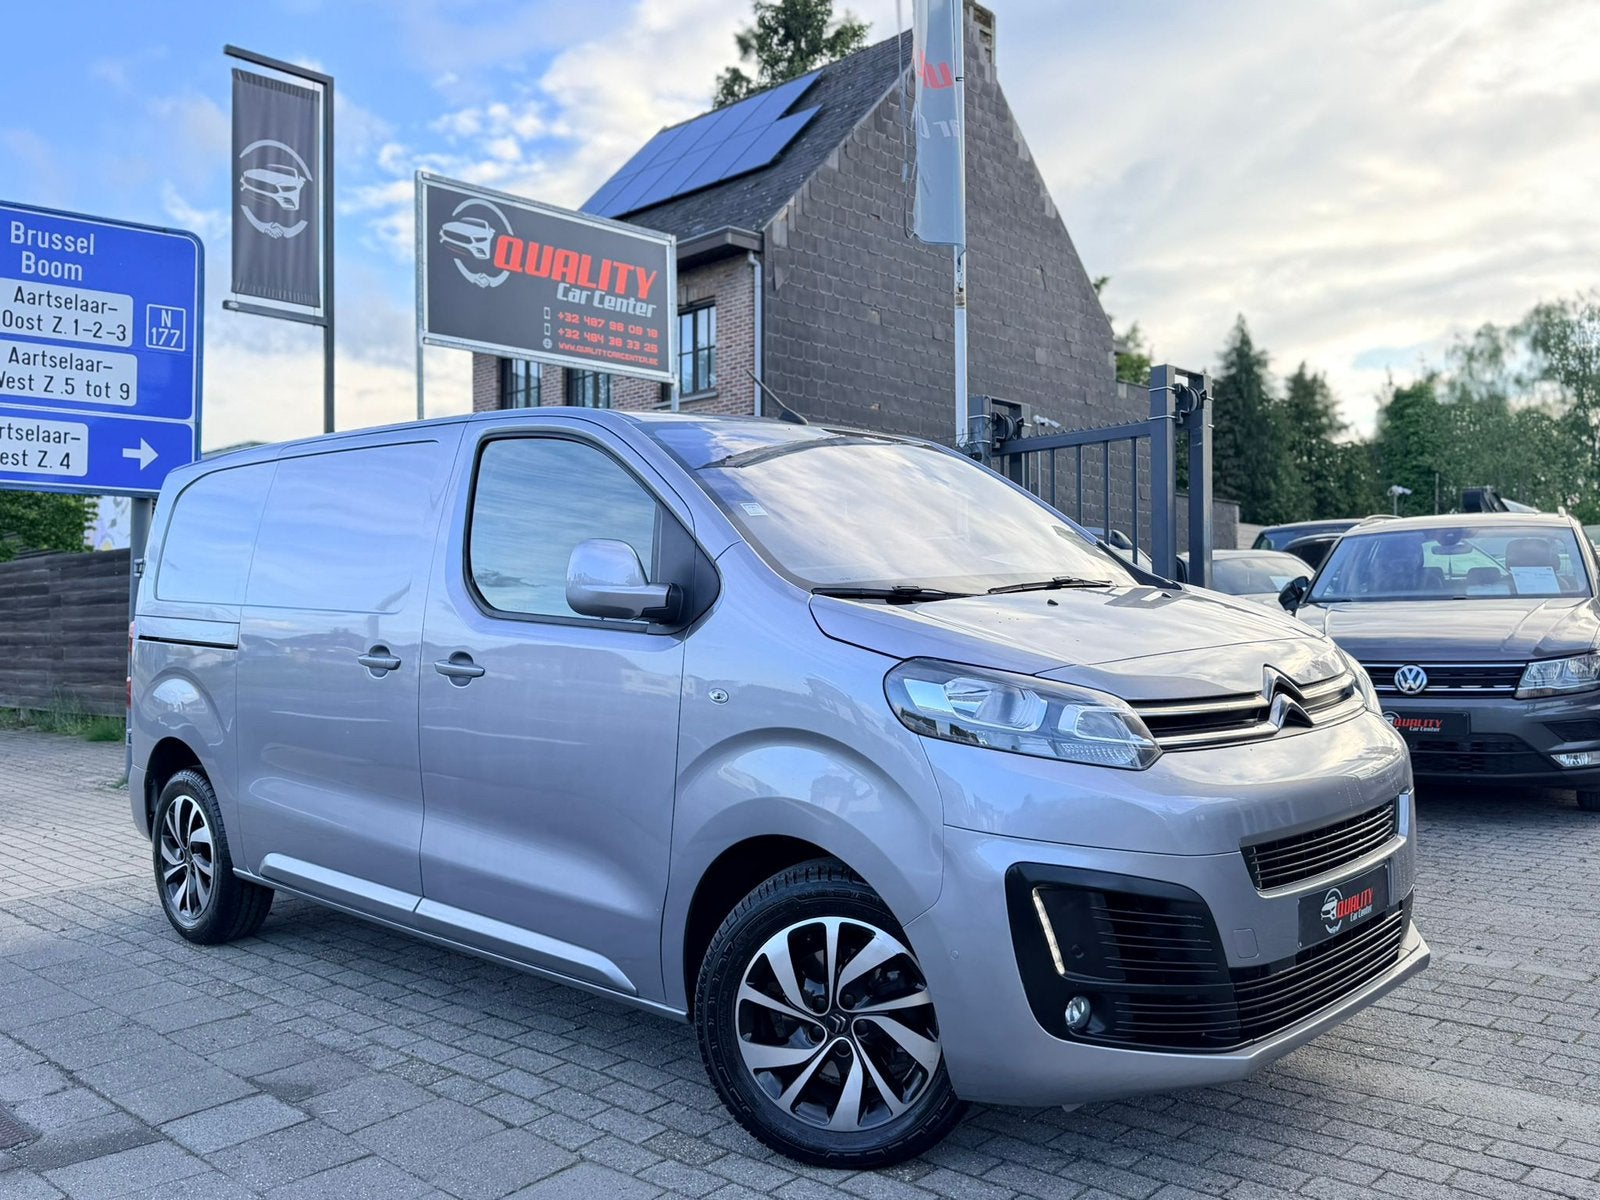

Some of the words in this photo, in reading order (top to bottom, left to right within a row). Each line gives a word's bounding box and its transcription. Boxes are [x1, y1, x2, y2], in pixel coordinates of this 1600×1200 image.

[10, 220, 95, 256] Brussel
[21, 250, 83, 281] Boom
[493, 234, 658, 300] QUALITY
[13, 286, 118, 314] Aartselaar-
[556, 282, 591, 306] Car
[593, 290, 657, 318] Center
[2, 309, 43, 332] Oost
[161, 309, 172, 328] N
[558, 311, 580, 324] +32
[151, 327, 181, 347] 177
[558, 327, 580, 340] +32
[8, 346, 113, 373] Aartselaar-
[86, 379, 111, 399] tot
[119, 382, 130, 401] 9
[1393, 717, 1443, 728] QUALITY
[1337, 888, 1373, 919] QUALITY
